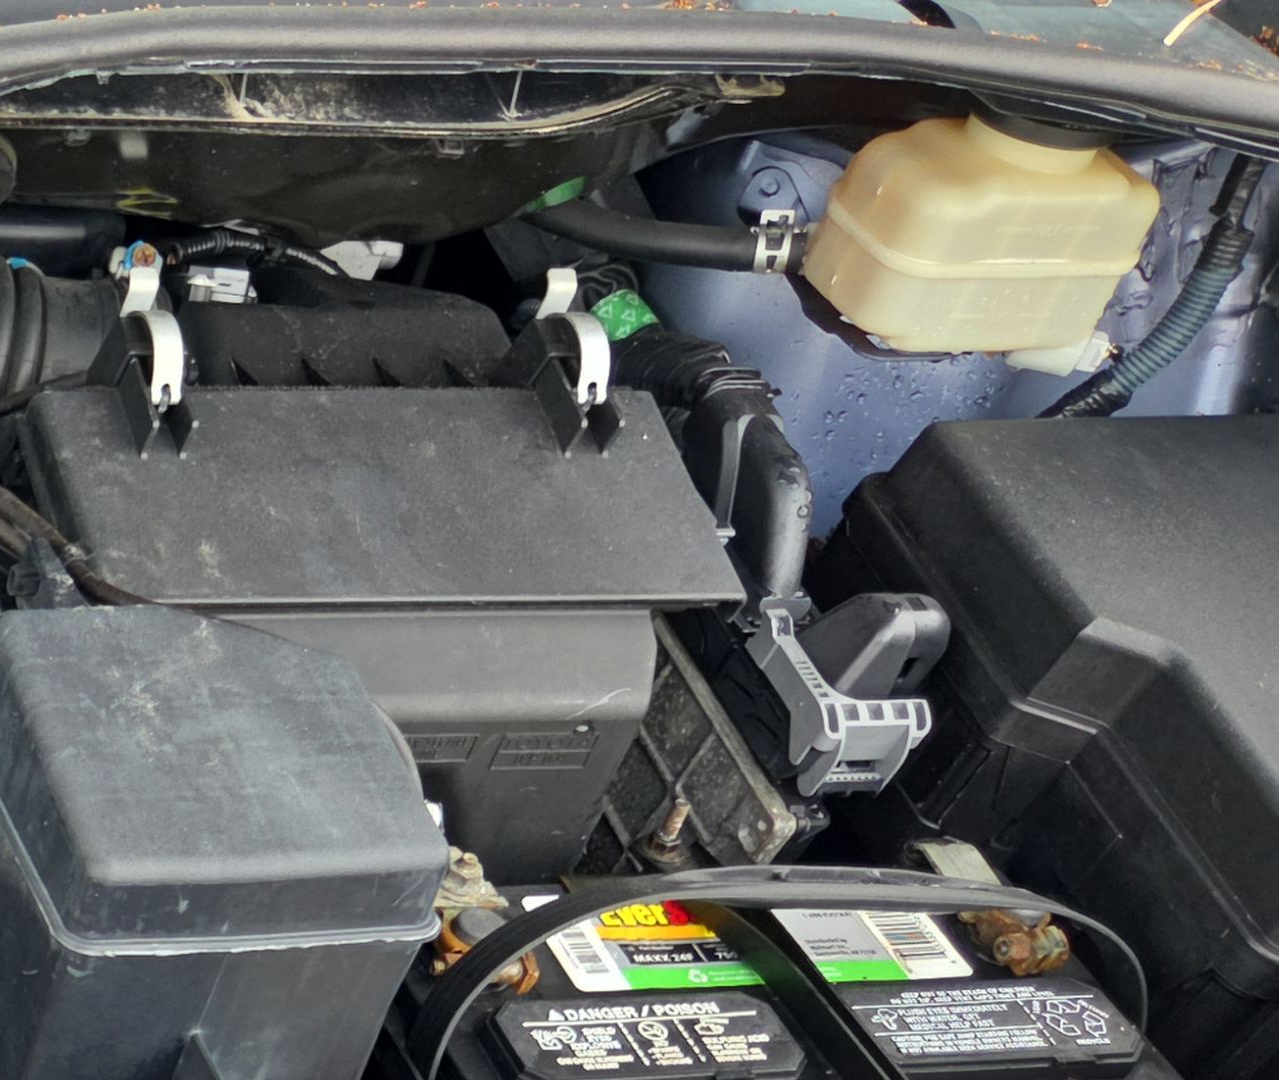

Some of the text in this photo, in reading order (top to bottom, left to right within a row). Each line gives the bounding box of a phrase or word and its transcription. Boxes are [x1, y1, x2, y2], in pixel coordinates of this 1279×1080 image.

[563, 1001, 720, 1020] DANGER / POISON
[897, 1004, 1008, 1016] FLUSH EYES IMMEDIATELY
[904, 1016, 928, 1024] WITH
[963, 1013, 981, 1021] GET
[909, 1019, 996, 1030] MEDICAL HELP FAST
